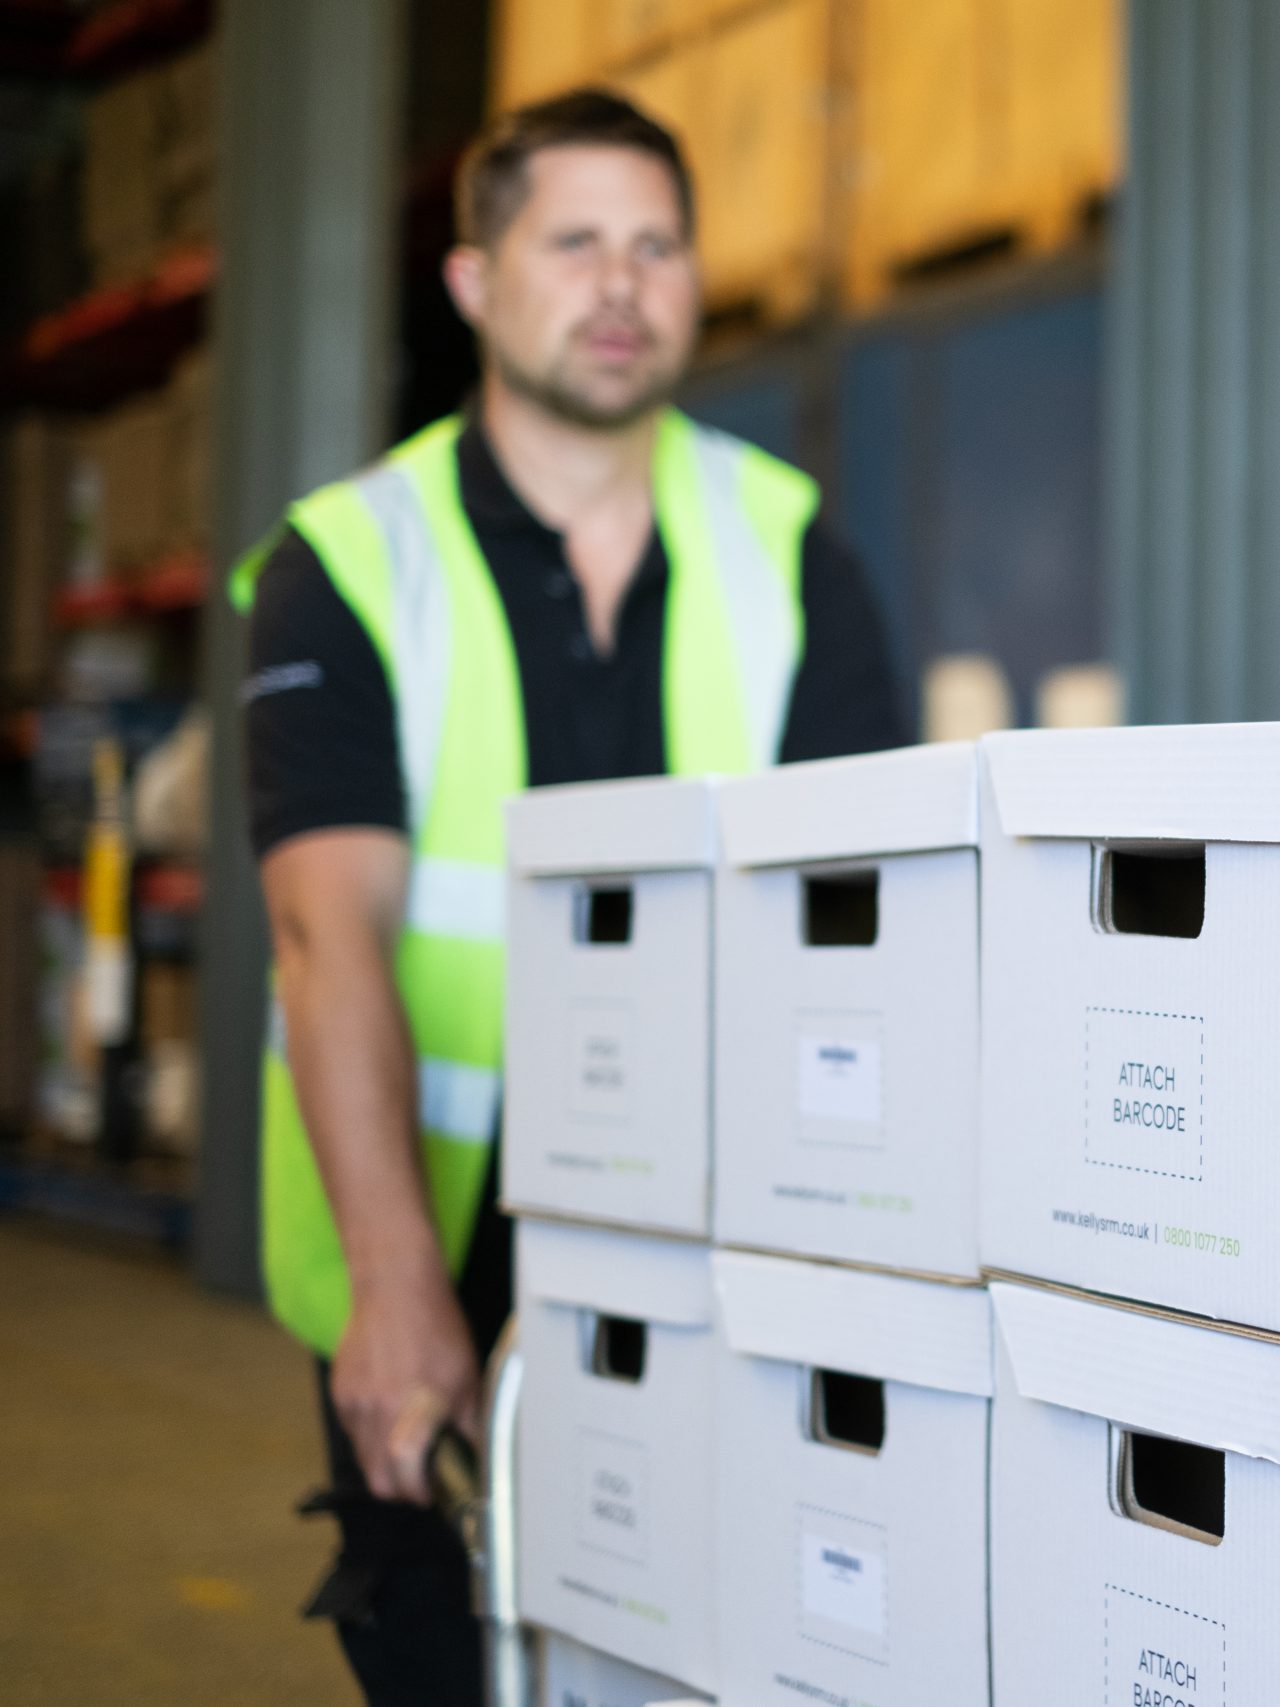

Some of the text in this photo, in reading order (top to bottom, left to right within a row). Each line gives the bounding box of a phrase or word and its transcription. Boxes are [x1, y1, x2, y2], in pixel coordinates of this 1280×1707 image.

[1118, 1061, 1176, 1093] ATTACH
[1113, 1097, 1186, 1132] BARCODE
[1051, 1207, 1241, 1258] www.kellysrm.co.uk 0800 1077 250
[1137, 1647, 1197, 1692] ATTACH
